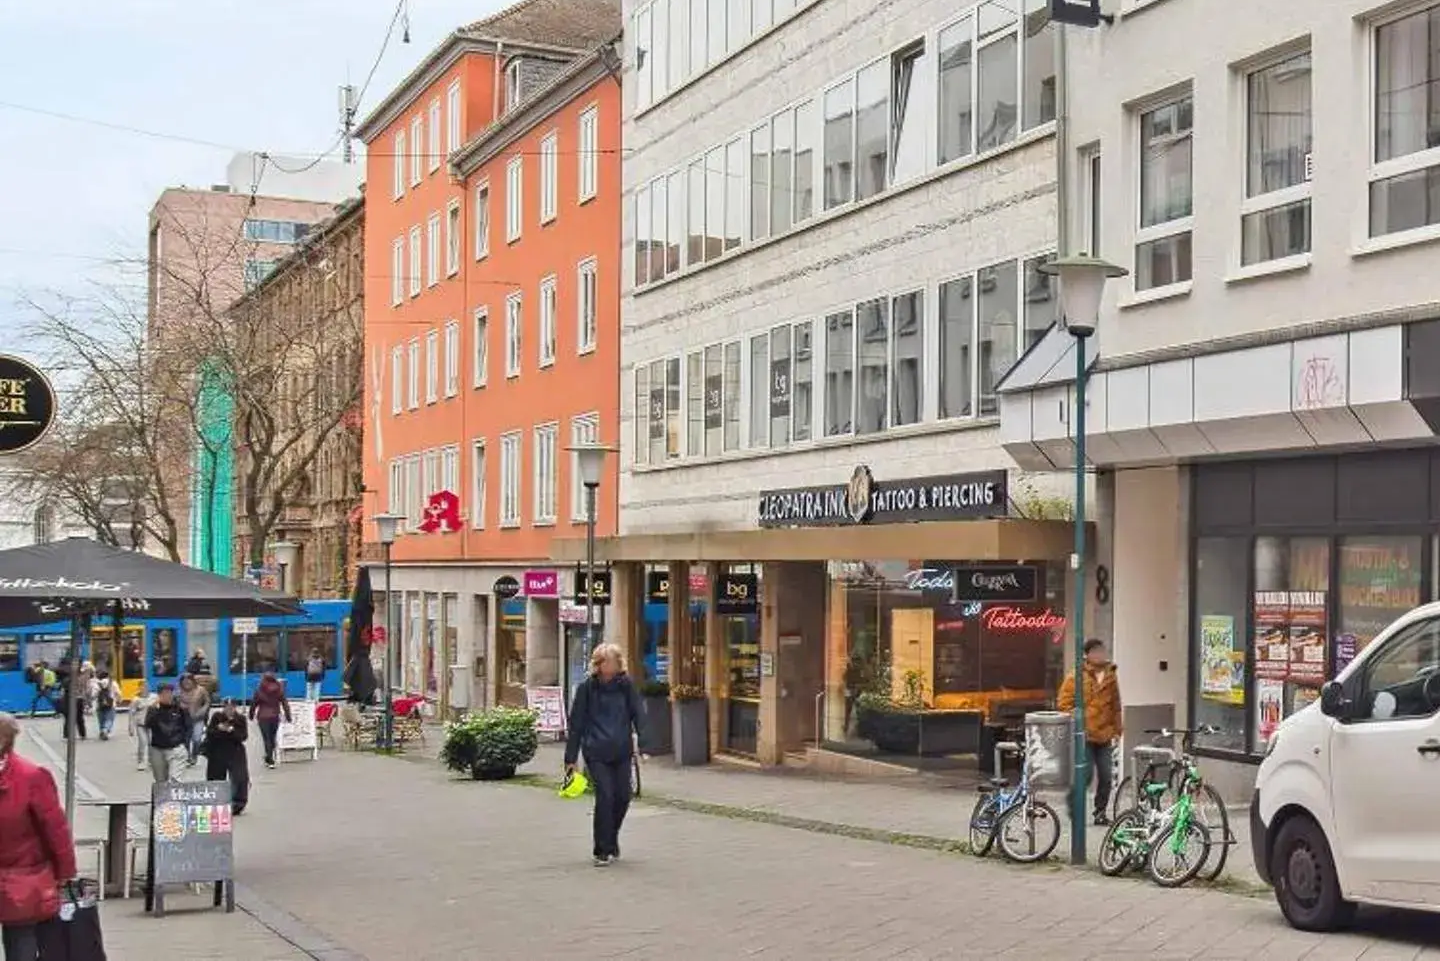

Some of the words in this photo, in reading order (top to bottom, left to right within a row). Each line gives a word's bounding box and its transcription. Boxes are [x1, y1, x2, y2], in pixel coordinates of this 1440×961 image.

[824, 489, 848, 517] INK
[871, 486, 916, 512] TATTOO
[919, 487, 927, 509] &
[932, 481, 994, 508] PIERCING
[727, 580, 748, 599] bg
[1095, 564, 1109, 605] 8
